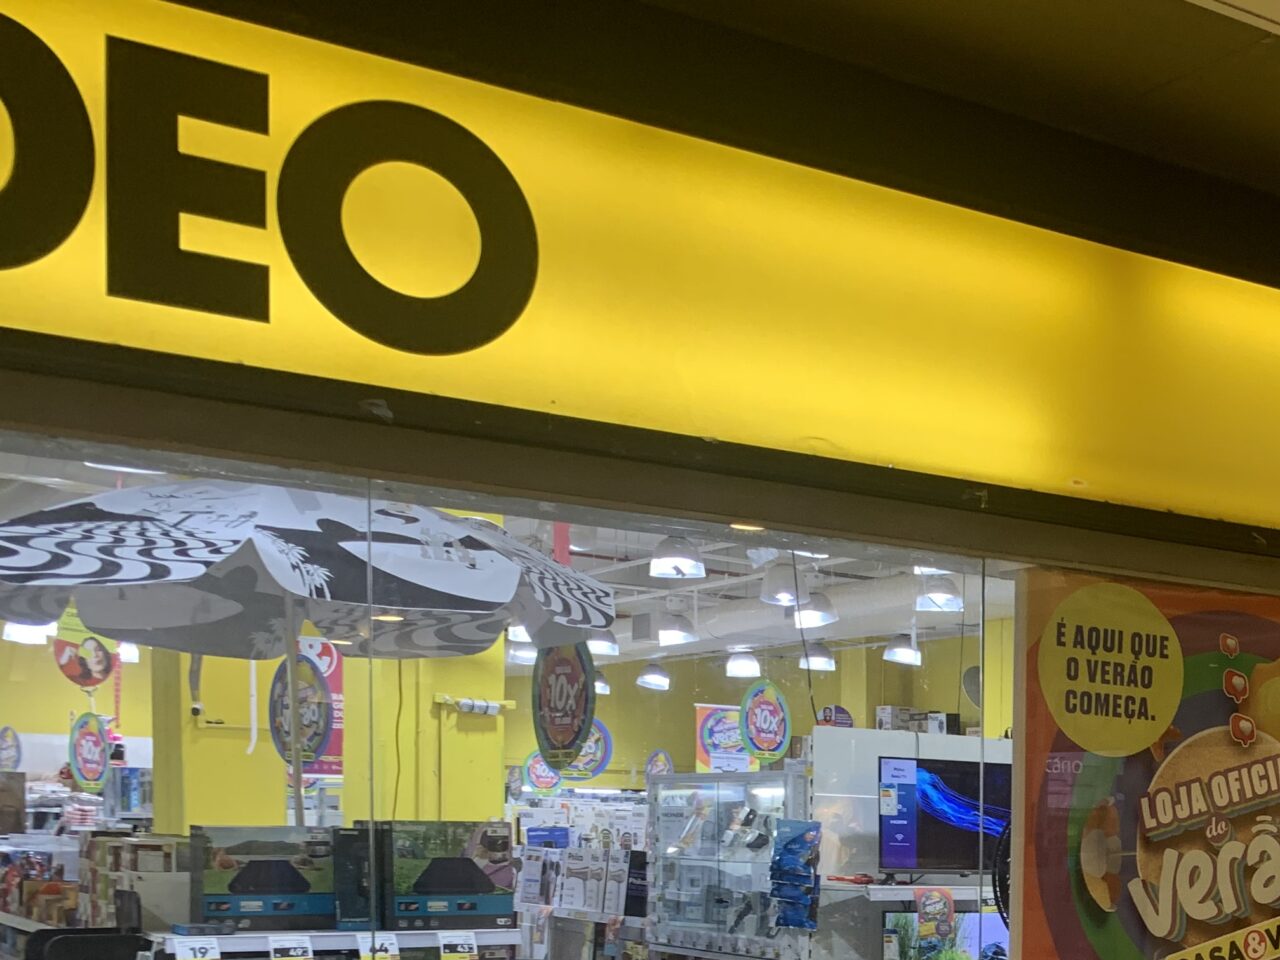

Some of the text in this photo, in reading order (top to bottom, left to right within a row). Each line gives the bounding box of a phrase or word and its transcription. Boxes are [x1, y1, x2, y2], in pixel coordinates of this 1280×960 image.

[1056, 618, 1169, 660] É AQUI QUE
[1066, 657, 1153, 689] O VERÃO
[1065, 689, 1156, 724] COMEÇA.
[1140, 781, 1201, 829] LOJA
